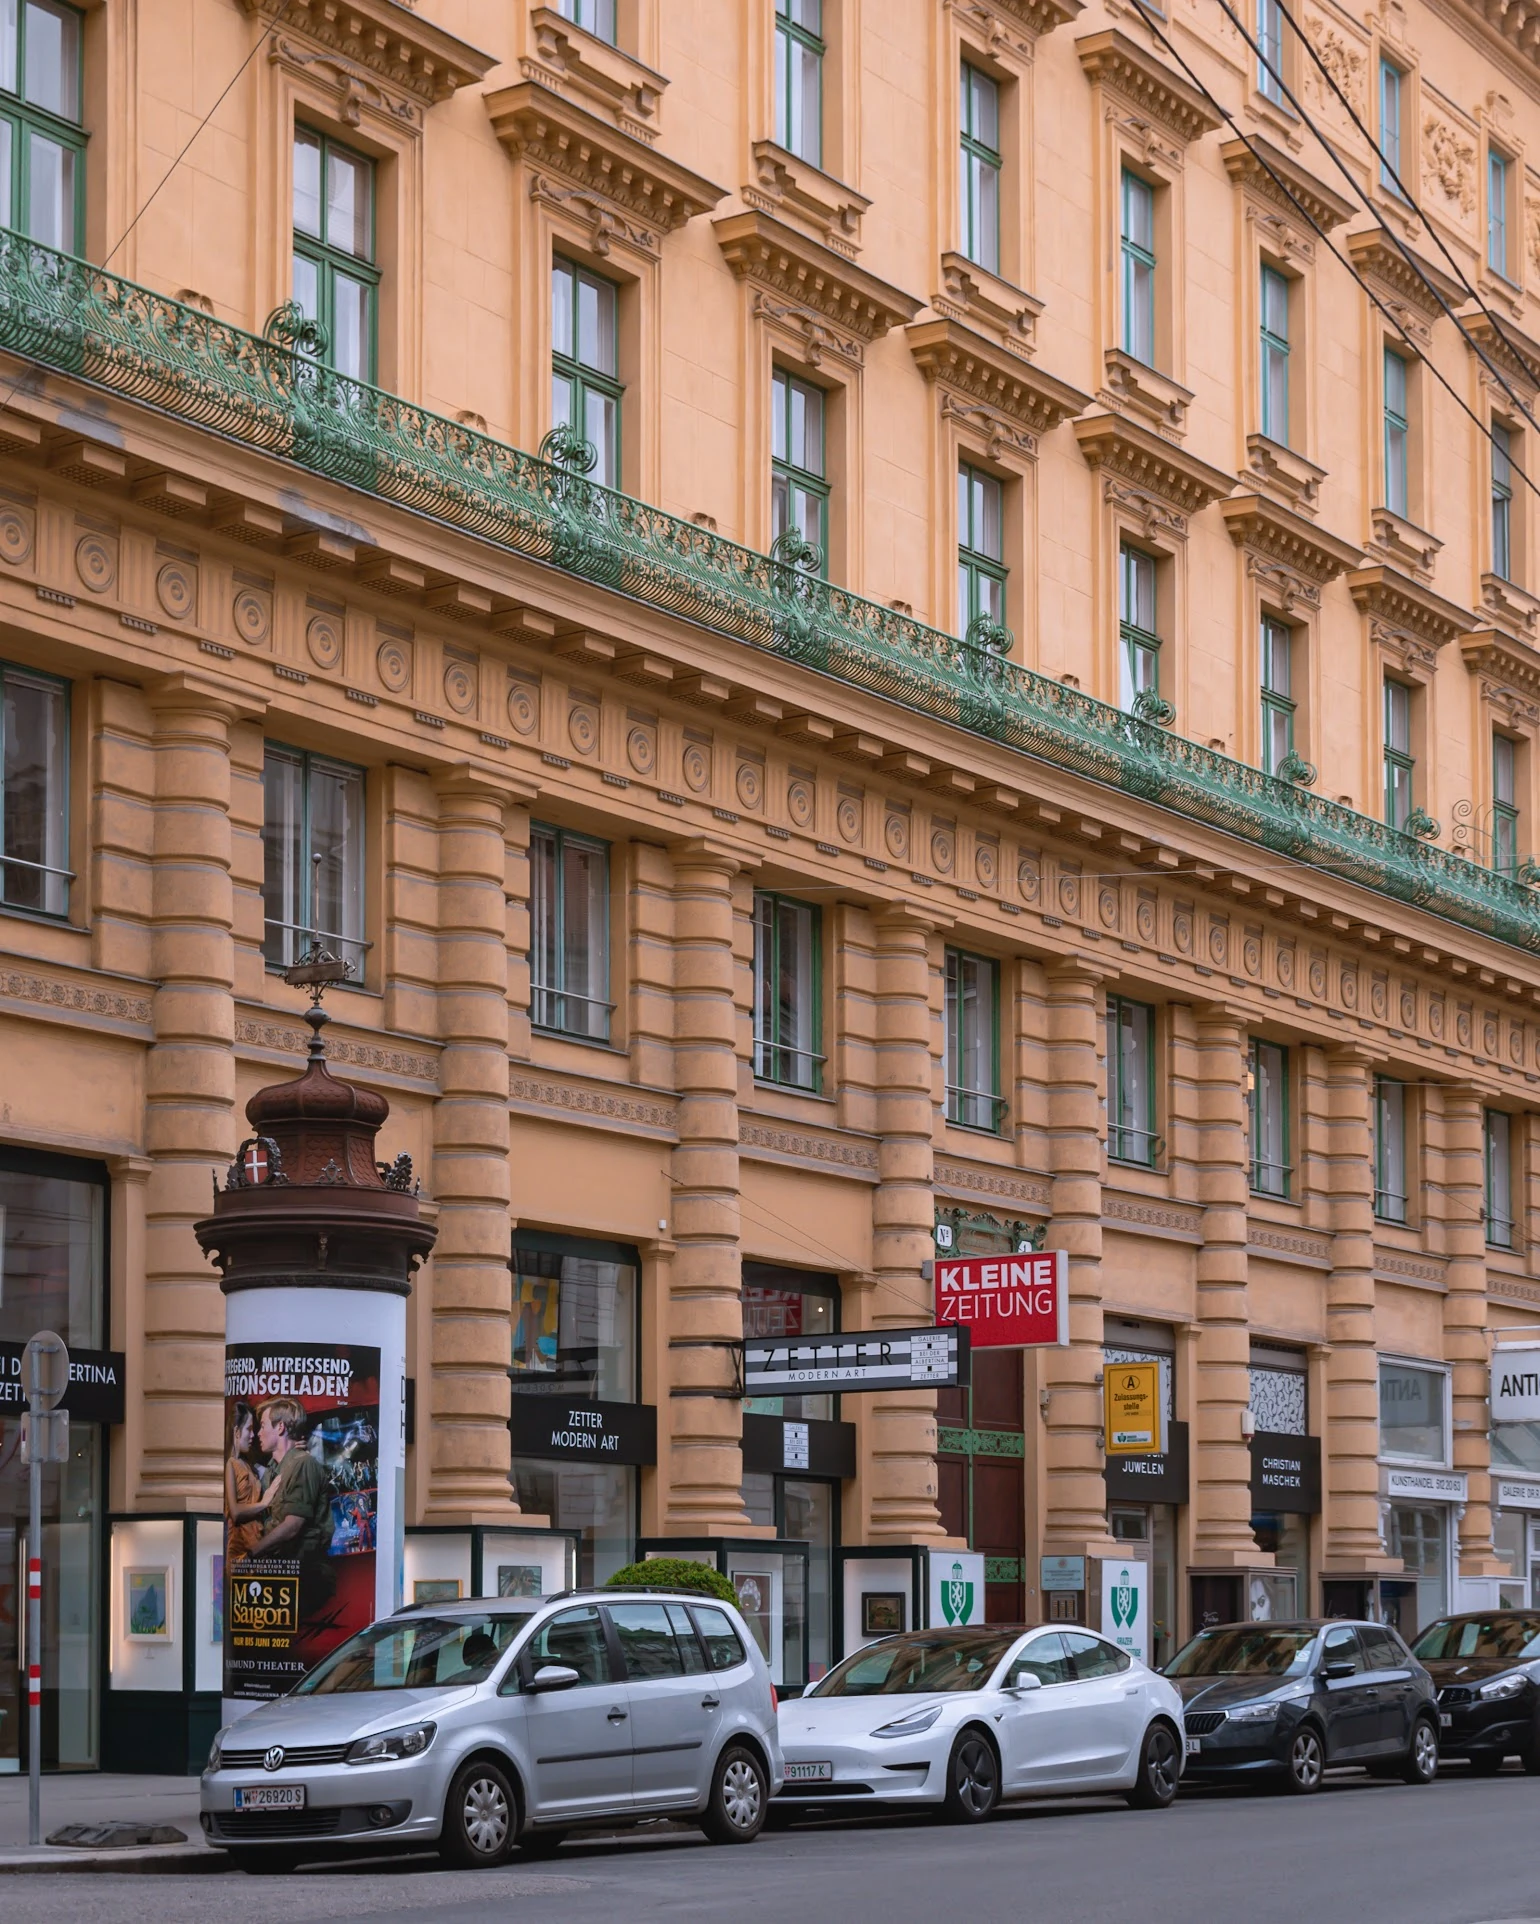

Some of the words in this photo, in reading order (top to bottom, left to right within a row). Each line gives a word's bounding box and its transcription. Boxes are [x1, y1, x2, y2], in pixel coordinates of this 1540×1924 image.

[941, 1260, 1052, 1292] KLEINE
[941, 1290, 1052, 1321] ZEITUNG
[763, 1342, 893, 1372] ZETTER
[68, 1362, 117, 1385] ERTINA
[262, 1357, 354, 1378] MITREISSEND,
[788, 1370, 839, 1381] MODERN
[845, 1368, 867, 1378] ART
[1500, 1373, 1540, 1397] ANTI
[1123, 1402, 1140, 1411] stelle
[568, 1410, 603, 1429] ZETTER
[551, 1430, 597, 1449] MODERN
[600, 1434, 620, 1450] ART
[1122, 1461, 1165, 1475] JUWELEN
[1262, 1457, 1301, 1471] CHRISTIAN
[1262, 1474, 1301, 1488] MASCHEK
[1391, 1475, 1435, 1489] KUNSTHANDEL
[233, 1603, 291, 1630] Saigon
[255, 1637, 270, 1647] JUNI
[272, 1638, 290, 1648] 2022
[257, 1661, 309, 1674] THEATER
[790, 1765, 817, 1778] 91117
